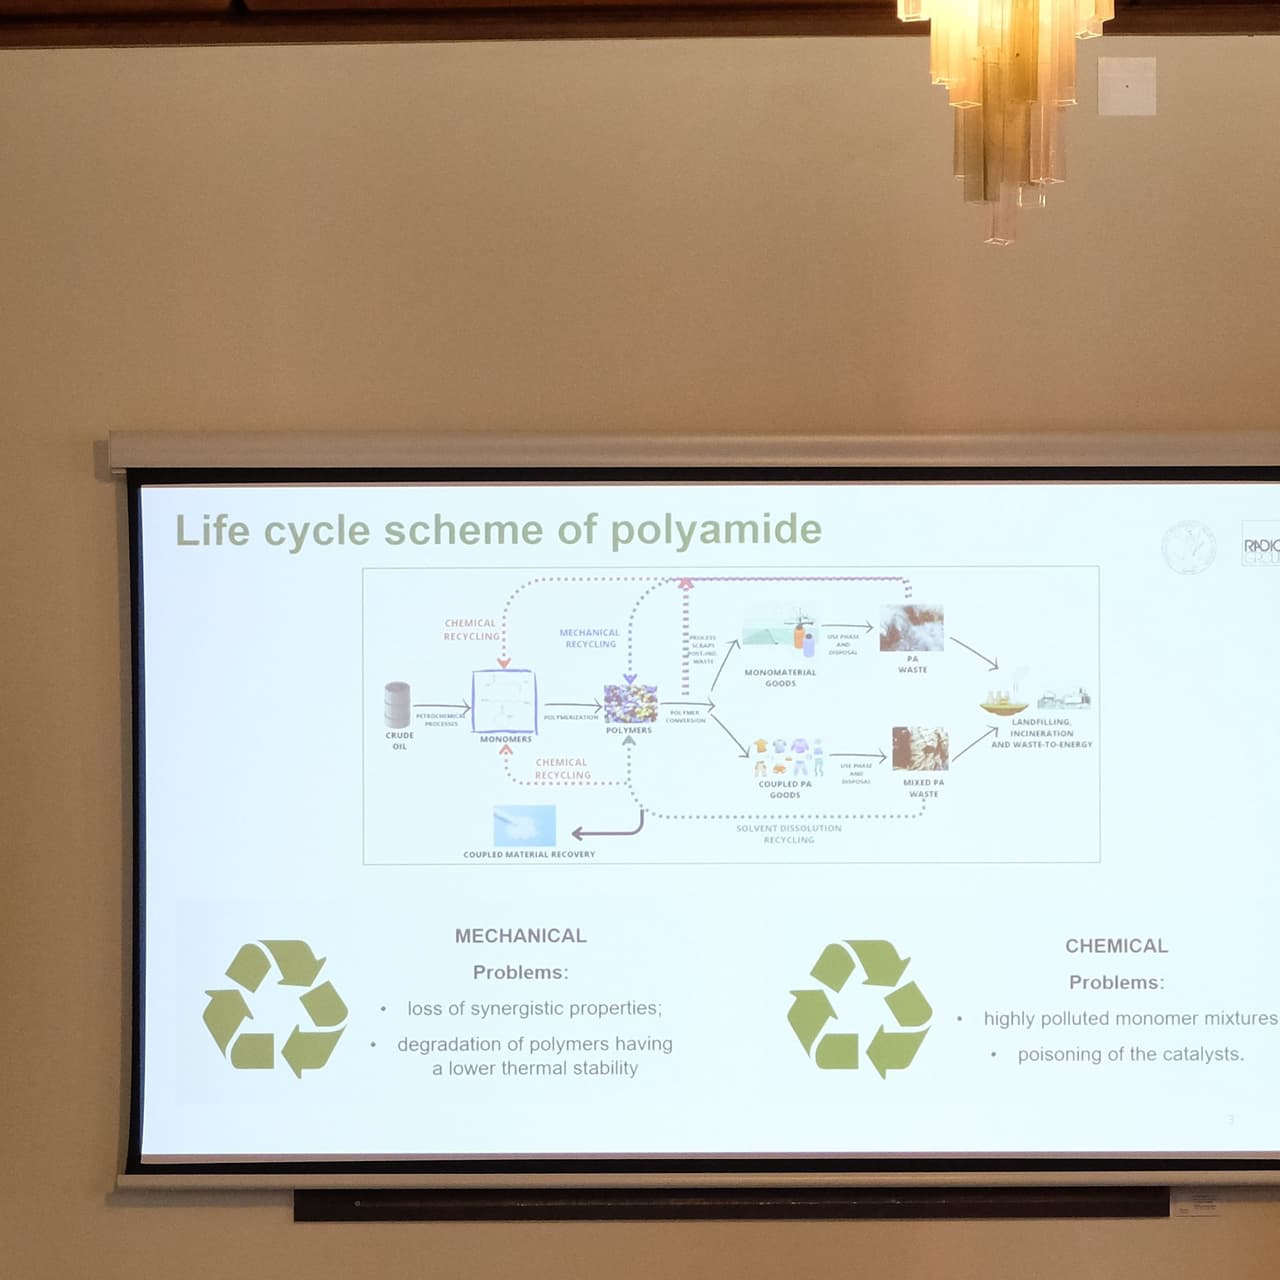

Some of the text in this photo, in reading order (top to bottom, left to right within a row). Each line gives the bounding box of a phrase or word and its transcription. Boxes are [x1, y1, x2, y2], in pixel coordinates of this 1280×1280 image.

[176, 512, 823, 555] Life cycle scheme of polyamide
[444, 618, 497, 628] CHEMICAL
[443, 631, 501, 641] RECYCLING
[559, 628, 621, 637] MECHANICAL
[565, 639, 617, 649] RECYCLING
[906, 655, 919, 663] PA
[744, 668, 817, 677] MONOMATERIAL
[897, 665, 928, 674] WASTE
[764, 679, 797, 688] GOODS
[543, 713, 599, 721] POLYMERIZATION
[669, 709, 700, 717] POLYMER
[424, 720, 459, 728] PROCESSES
[1011, 717, 1072, 727] LANDFILLING,
[384, 731, 415, 740] CRUDE
[605, 726, 653, 735] POLYMERS
[1010, 729, 1075, 738] INCINERATION
[479, 734, 533, 744] MONOMERS
[391, 742, 408, 751] OIL
[991, 740, 1093, 749] AND WASTE-TO-ENERGY
[535, 757, 588, 767] CHEMICAL
[534, 770, 592, 780] RECYCLING
[758, 780, 813, 789] COUPLED PA
[903, 778, 945, 787] MIXED PA
[769, 791, 801, 800] GOODS
[908, 790, 939, 799] WASTE
[736, 823, 843, 833] SOLVENT DISSOLUTION
[763, 835, 815, 845] RECYCLING
[463, 850, 596, 859] COUPLED MATERIAL RECOVERY
[455, 928, 588, 944] MECHANICAL
[1065, 938, 1169, 954] CHEMICAL
[473, 965, 569, 980] Problems:
[1069, 975, 1165, 990] Problems:
[408, 1000, 662, 1020] loss of synergistic properties;
[984, 1010, 1279, 1030] highly polluted monomer mixtures
[397, 1036, 673, 1056] degradation of polymers having
[1018, 1046, 1245, 1066] poisoning of the catalysts.
[432, 1060, 639, 1079] a lower thermal stability
